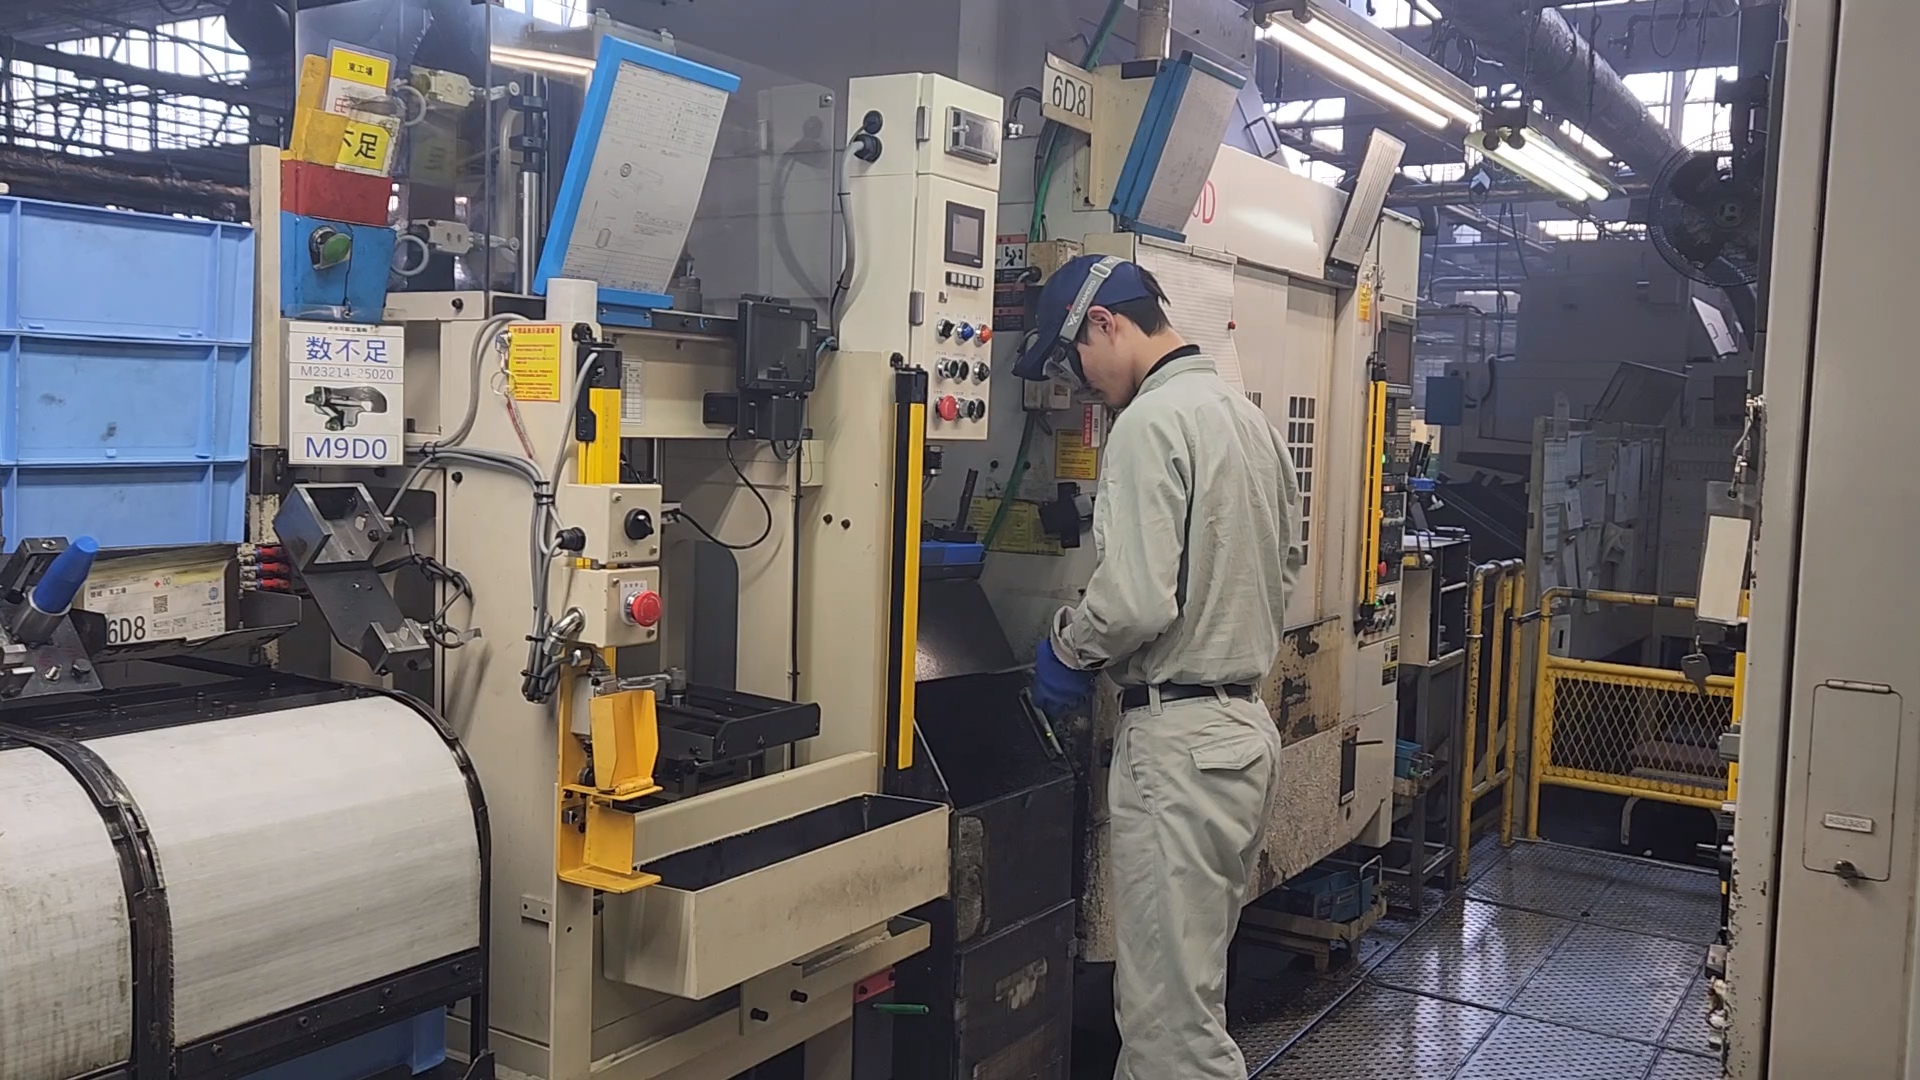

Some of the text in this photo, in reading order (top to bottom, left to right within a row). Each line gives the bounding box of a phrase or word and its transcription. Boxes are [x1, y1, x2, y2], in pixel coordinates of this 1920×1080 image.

[347, 62, 373, 76] 東工場
[1053, 75, 1086, 117] 6D8
[306, 336, 389, 364] 数不足
[300, 365, 394, 380] M23214-25020
[305, 436, 387, 460] M9D0
[108, 615, 146, 644] 6D8
